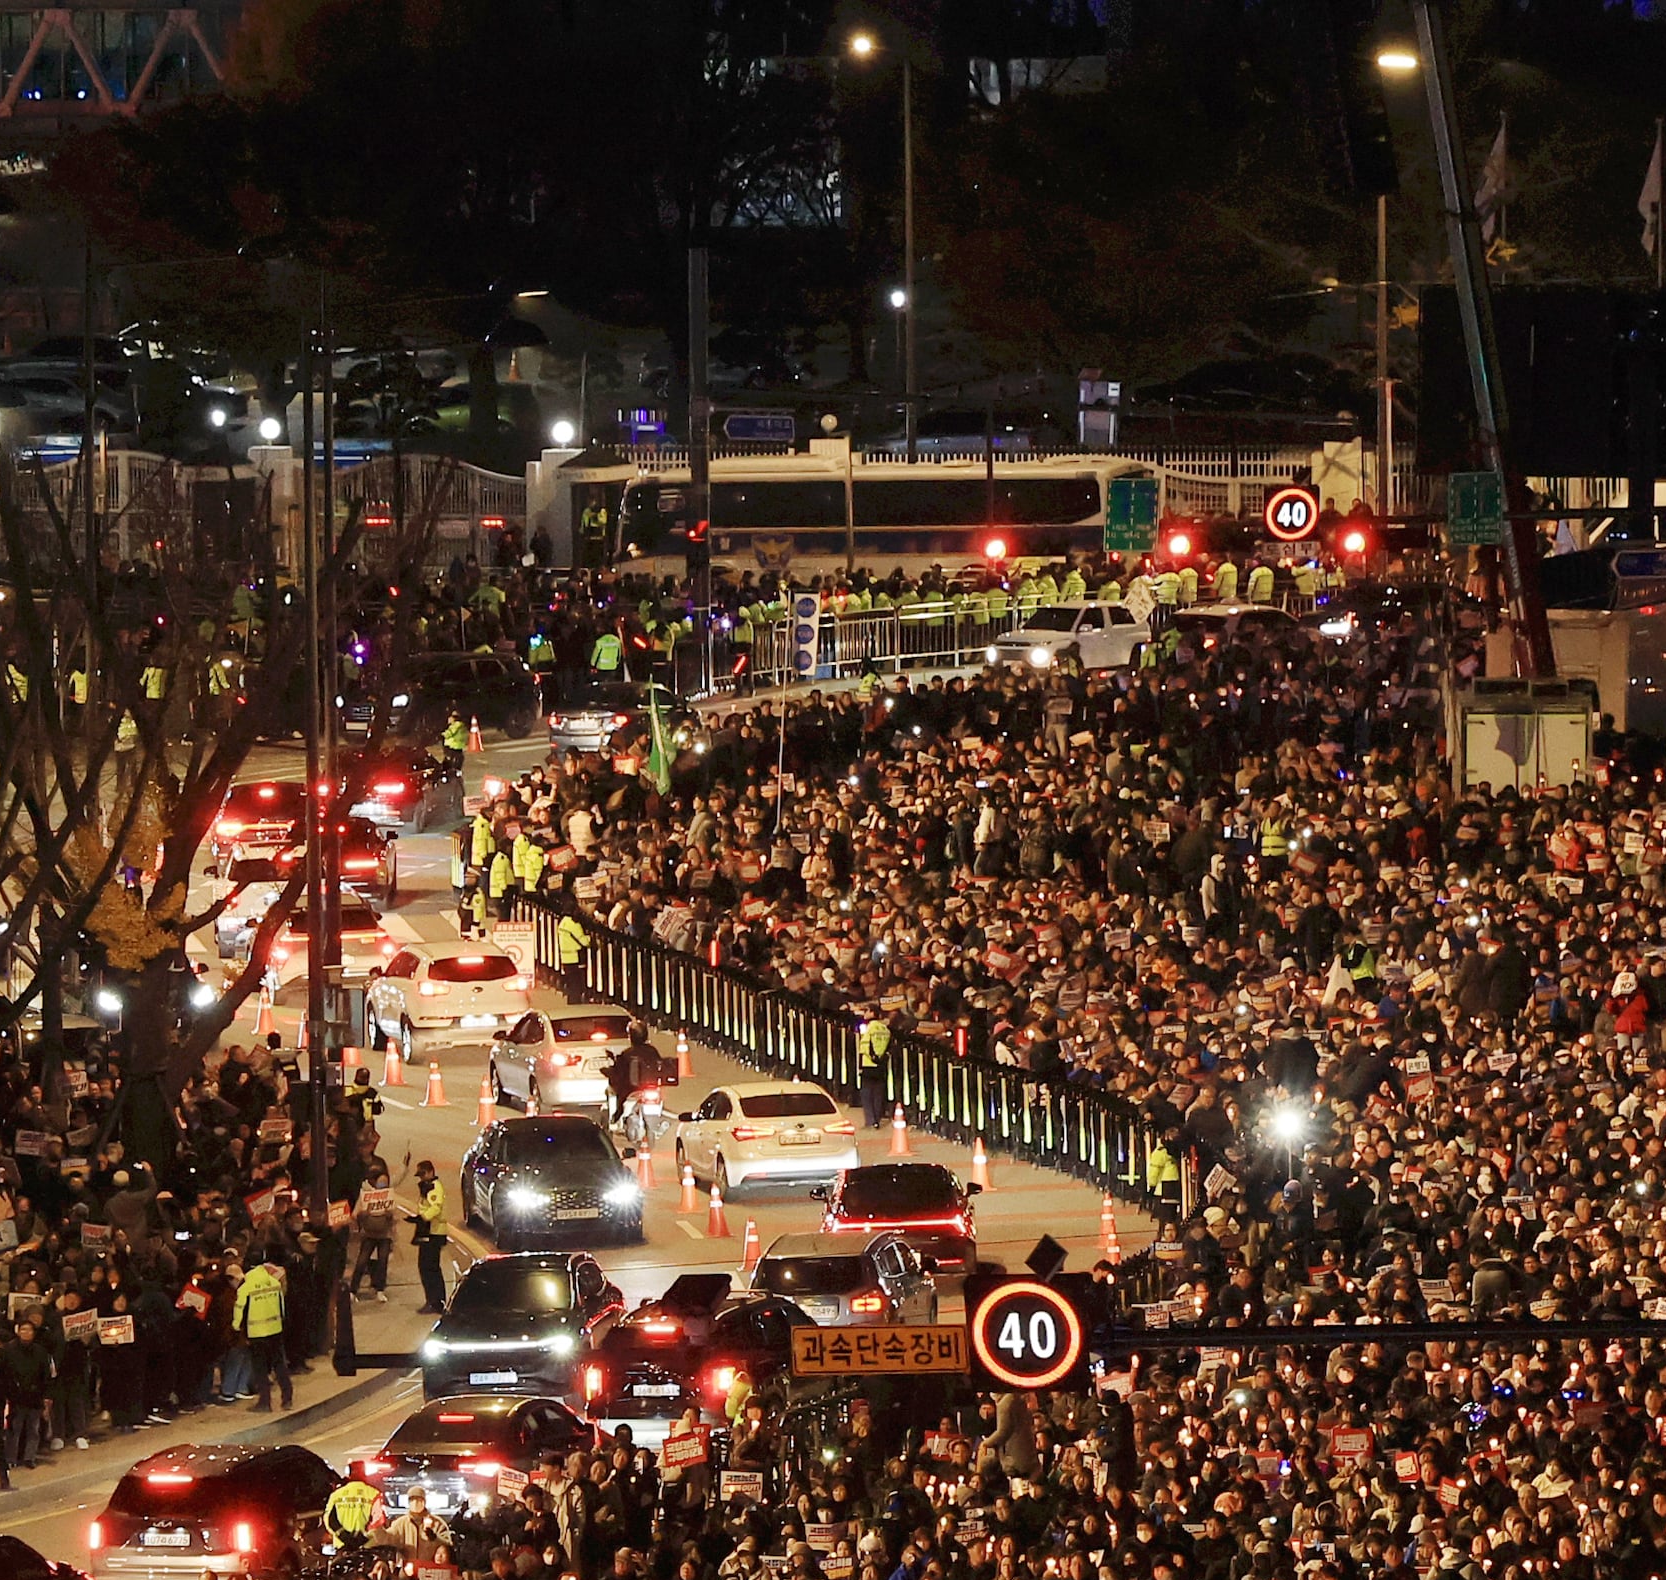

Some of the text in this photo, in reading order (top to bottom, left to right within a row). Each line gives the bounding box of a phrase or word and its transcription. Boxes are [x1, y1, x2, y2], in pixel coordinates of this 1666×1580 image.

[1277, 501, 1306, 527] 40
[803, 1332, 961, 1366] 과속단속장비
[998, 1311, 1056, 1359] 40
